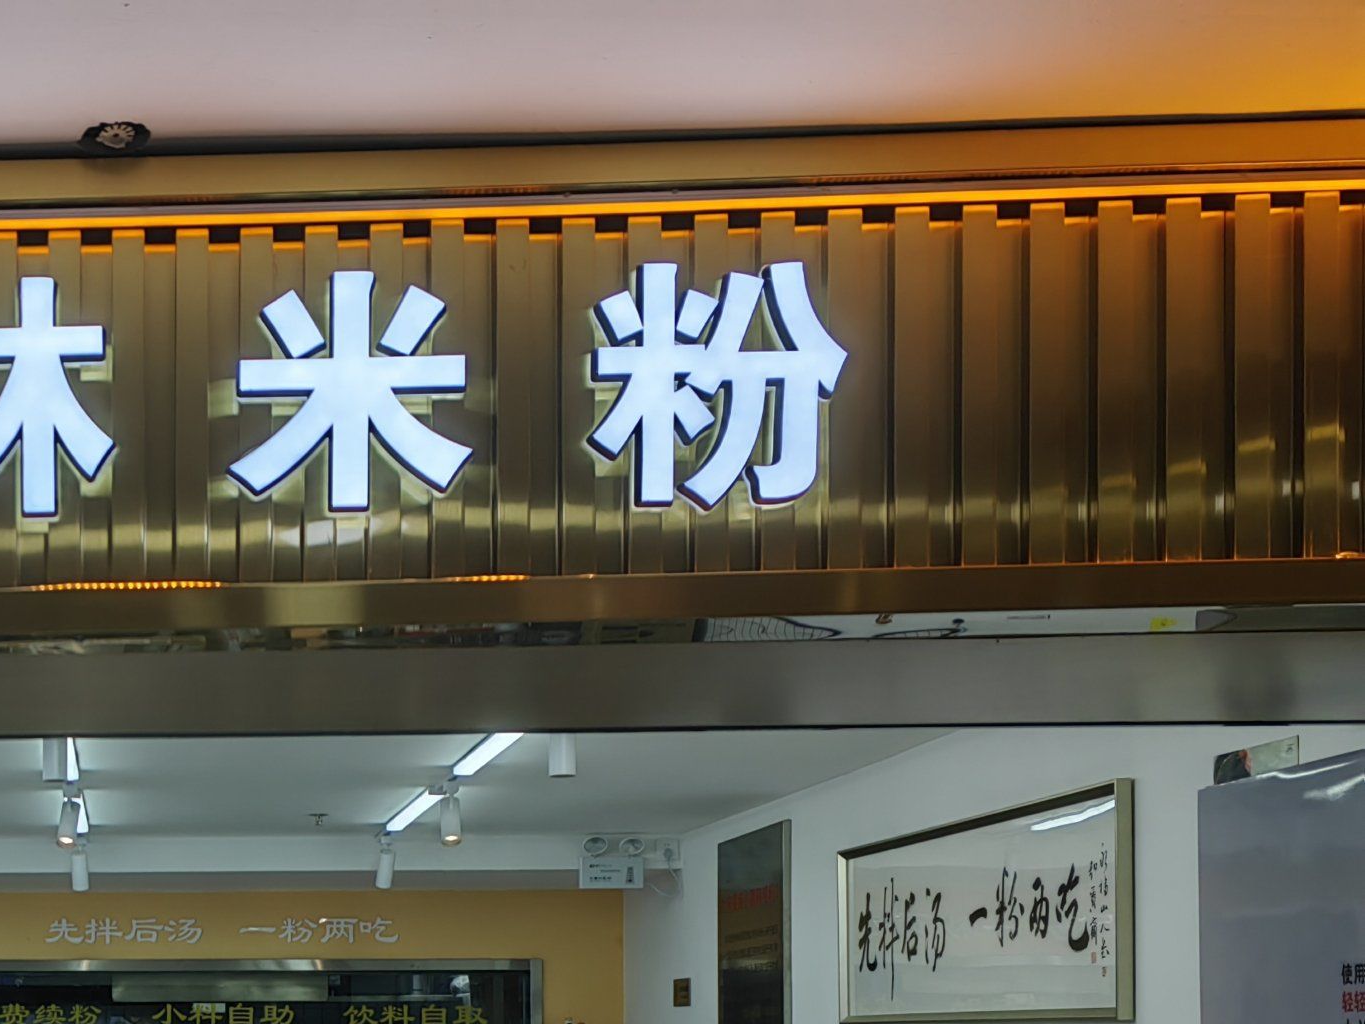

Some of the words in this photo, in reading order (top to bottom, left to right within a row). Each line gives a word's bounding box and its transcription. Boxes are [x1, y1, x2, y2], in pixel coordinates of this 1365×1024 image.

[45, 917, 204, 945] 先拌后汤
[238, 917, 401, 944] 一粉两吃
